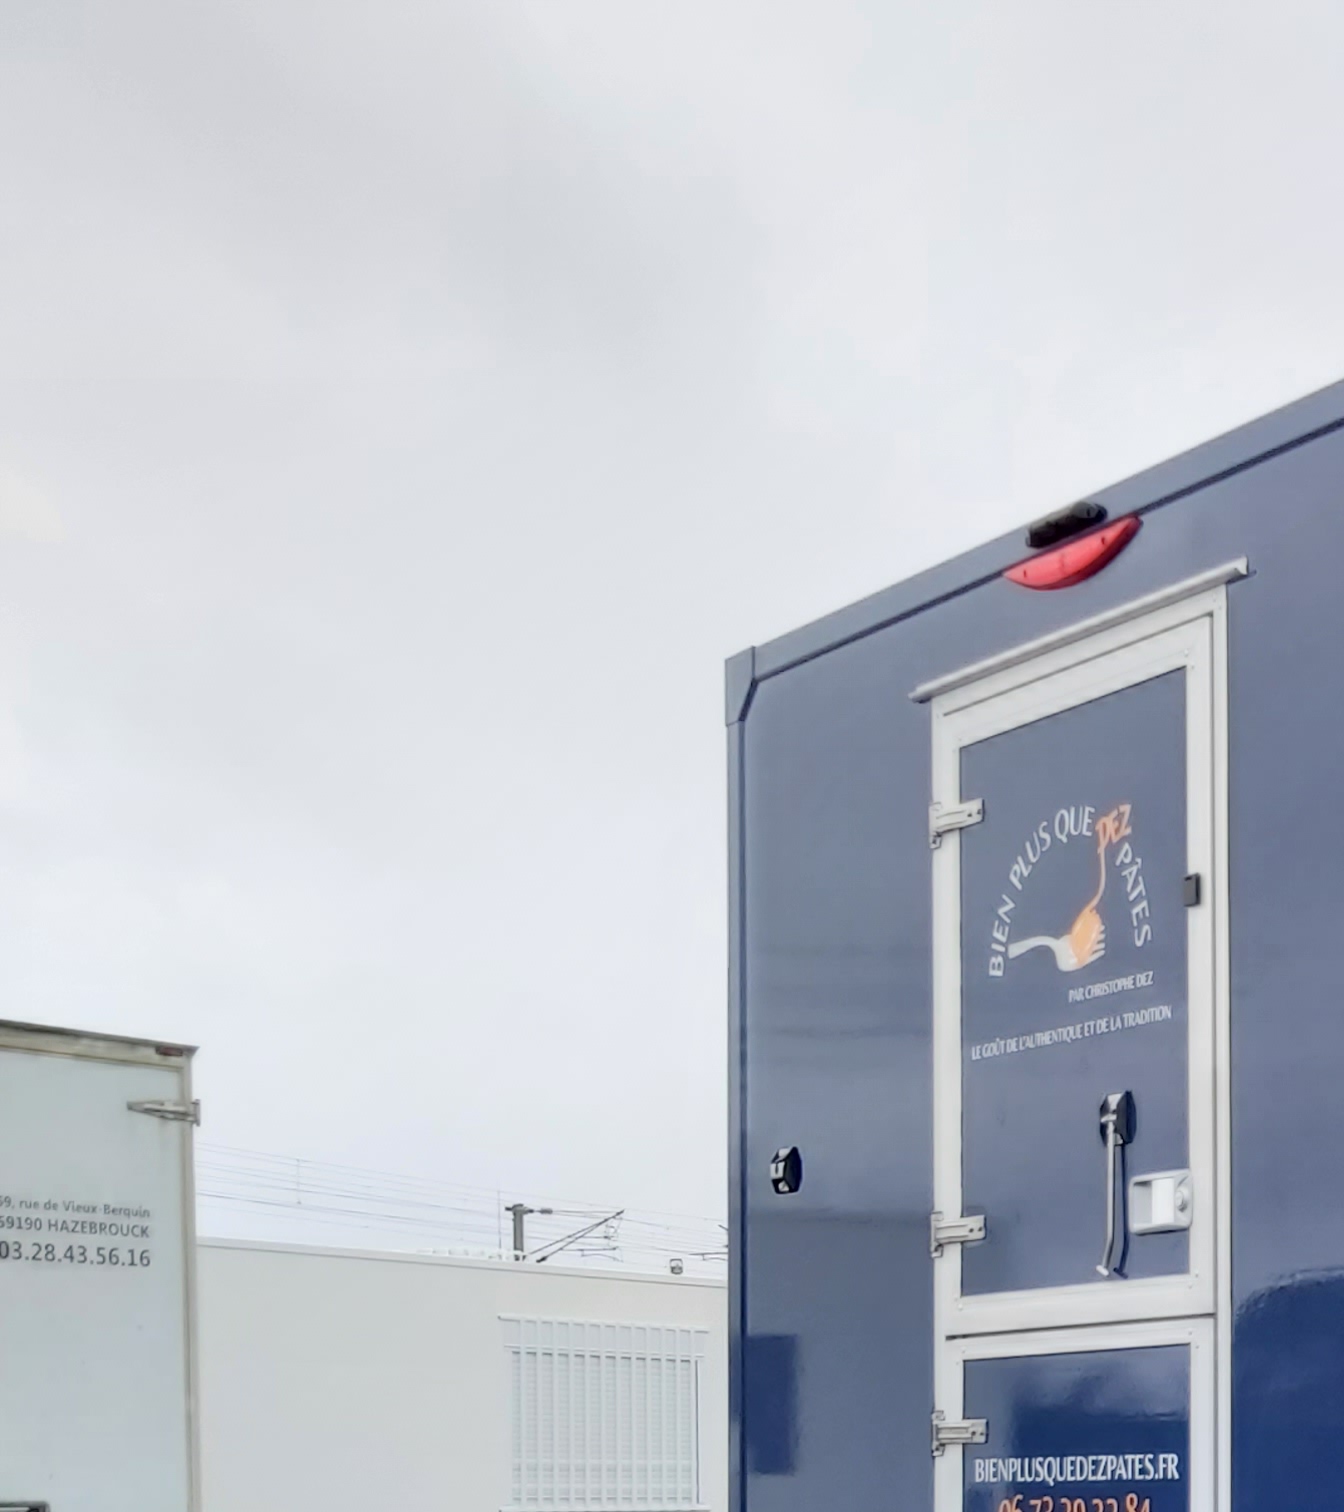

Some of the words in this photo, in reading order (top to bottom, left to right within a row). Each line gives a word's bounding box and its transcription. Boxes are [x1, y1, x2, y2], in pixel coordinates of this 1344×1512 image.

[989, 894, 1016, 977] BIEN
[1009, 821, 1051, 890] PLUS
[1054, 805, 1095, 843] QUE
[1095, 804, 1132, 854] DEZ
[1115, 842, 1152, 947] PÂTES
[1068, 987, 1084, 1003] PAR
[1085, 975, 1135, 999] CHRISTOPHE
[1136, 971, 1153, 988] DEZ
[971, 1045, 981, 1060] LE
[982, 1037, 1005, 1058] GOÛT
[1006, 1037, 1018, 1053] DE
[1019, 1023, 1083, 1051] L'AUTHENTIQUE
[1084, 1020, 1095, 1037] ET
[1096, 1017, 1109, 1034] DE
[1110, 1015, 1122, 1031] LA
[1122, 1004, 1172, 1028] TRADITION
[19, 1199, 40, 1210] rue
[44, 1199, 59, 1211] de
[48, 1219, 149, 1238] HAZEBROUCK
[0, 1240, 150, 1267] 03.28.43.56.16
[974, 1453, 1180, 1486] BIENPLUSQUEDEZPATES.FR
